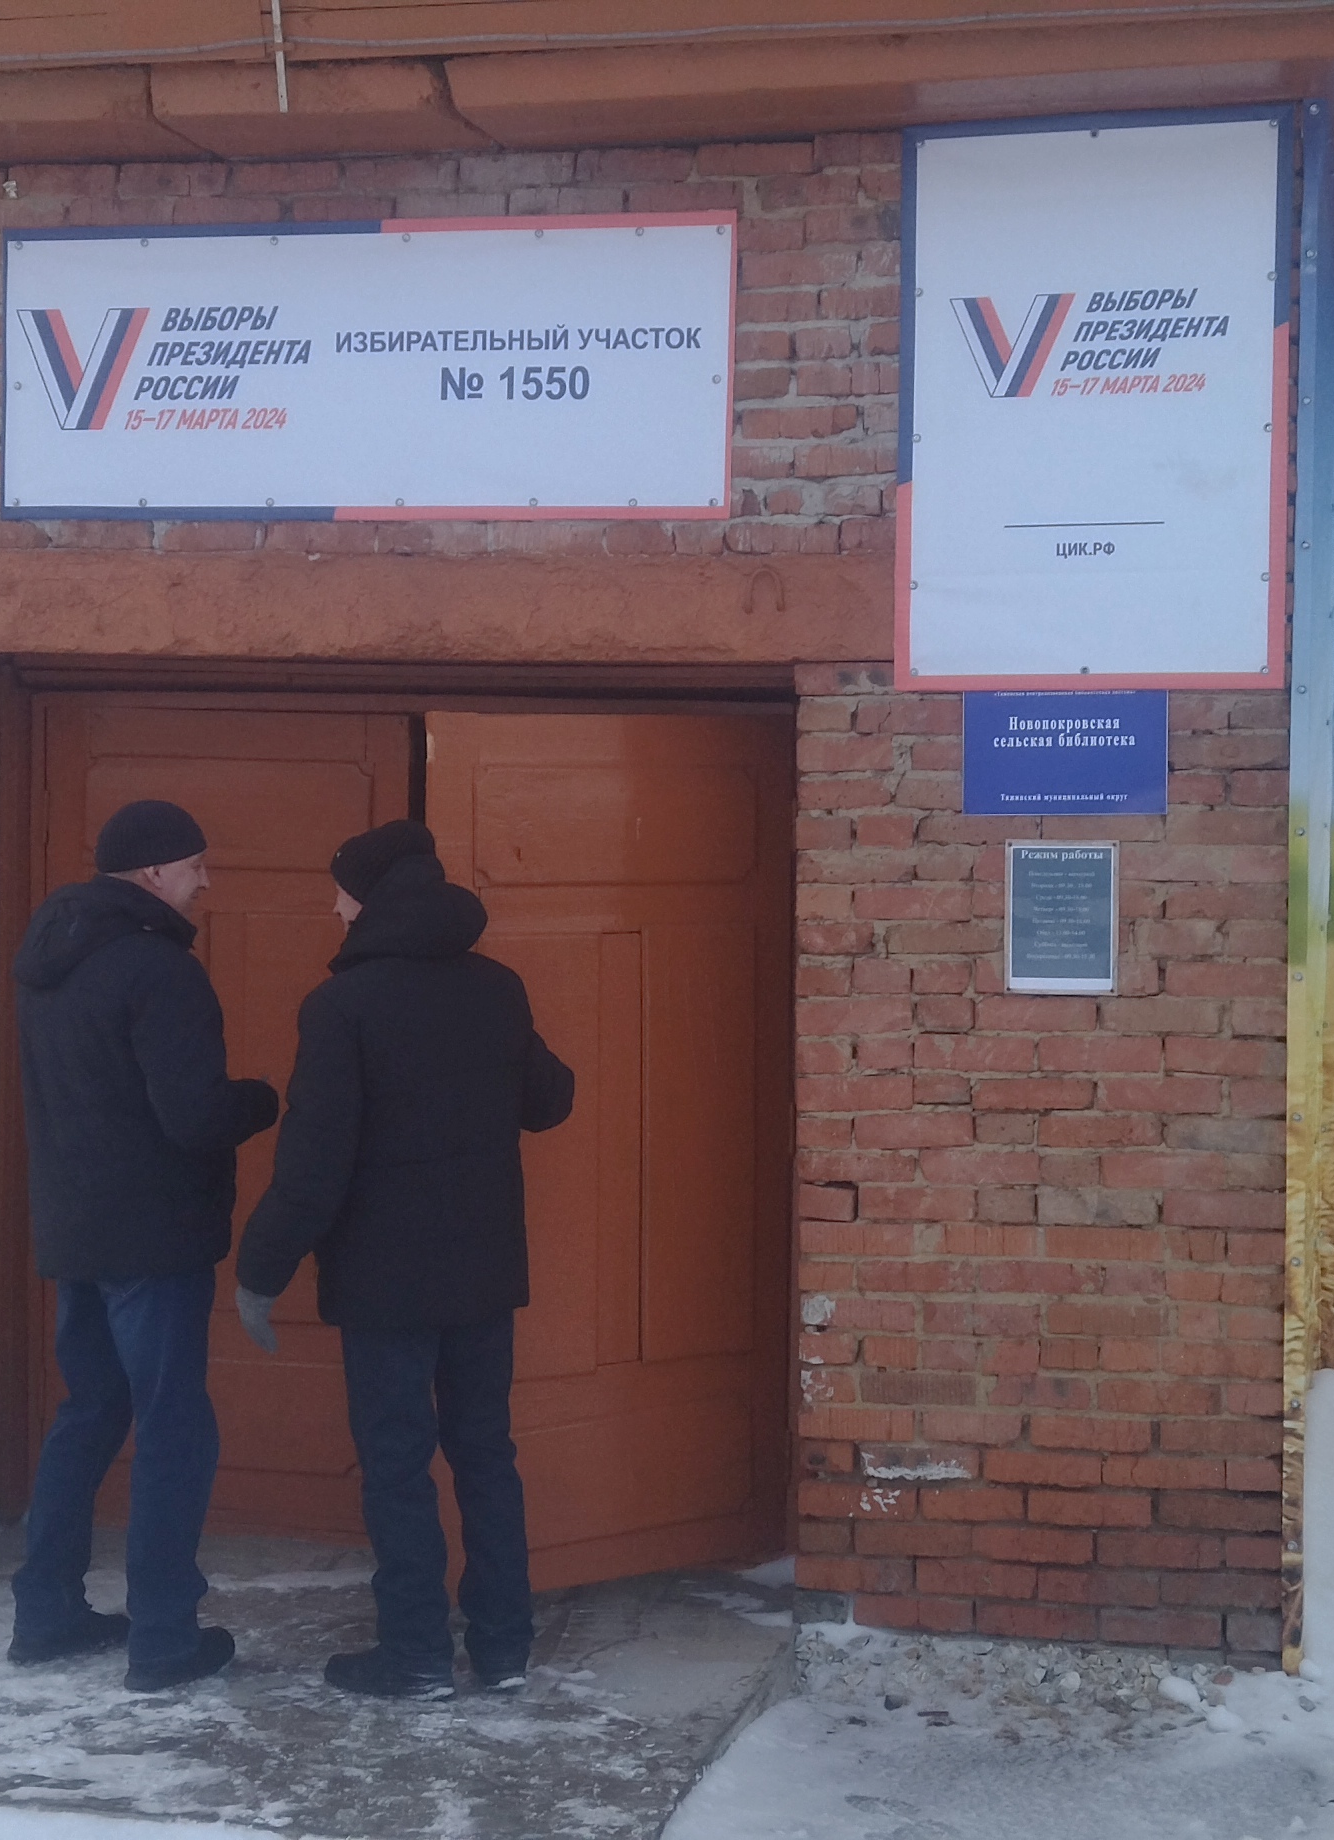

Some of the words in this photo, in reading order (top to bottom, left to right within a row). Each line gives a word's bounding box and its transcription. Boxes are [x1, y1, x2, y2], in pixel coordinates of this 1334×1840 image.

[1086, 288, 1198, 312] ВЫБОРЫ
[161, 306, 278, 331] ВЫБОРЫ
[1073, 316, 1229, 342] ПРЕЗИДЕНТА
[336, 325, 568, 352] ИЗБИРАТЕЛЬНЫЙ
[577, 327, 702, 350] УЧАСТОК
[147, 340, 311, 368] ПРЕЗИДЕНТА
[1060, 348, 1161, 371] РОССИИ
[134, 376, 240, 400] РОССИИ
[441, 367, 483, 400] №
[500, 366, 589, 400] 1550
[1097, 374, 1161, 395] МАРТА
[1161, 373, 1207, 393] 2024
[174, 407, 239, 431] МАРТА
[241, 407, 288, 430] 2024
[1056, 542, 1116, 559] ЦИК.РФ
[1008, 716, 1120, 733] Новопокровская
[993, 736, 1053, 748] сельская
[1058, 732, 1136, 747] библиотека
[1043, 793, 1104, 802] муниципальный
[1105, 793, 1128, 802] округ
[1021, 849, 1058, 859] Режим
[1061, 849, 1104, 862] работы
